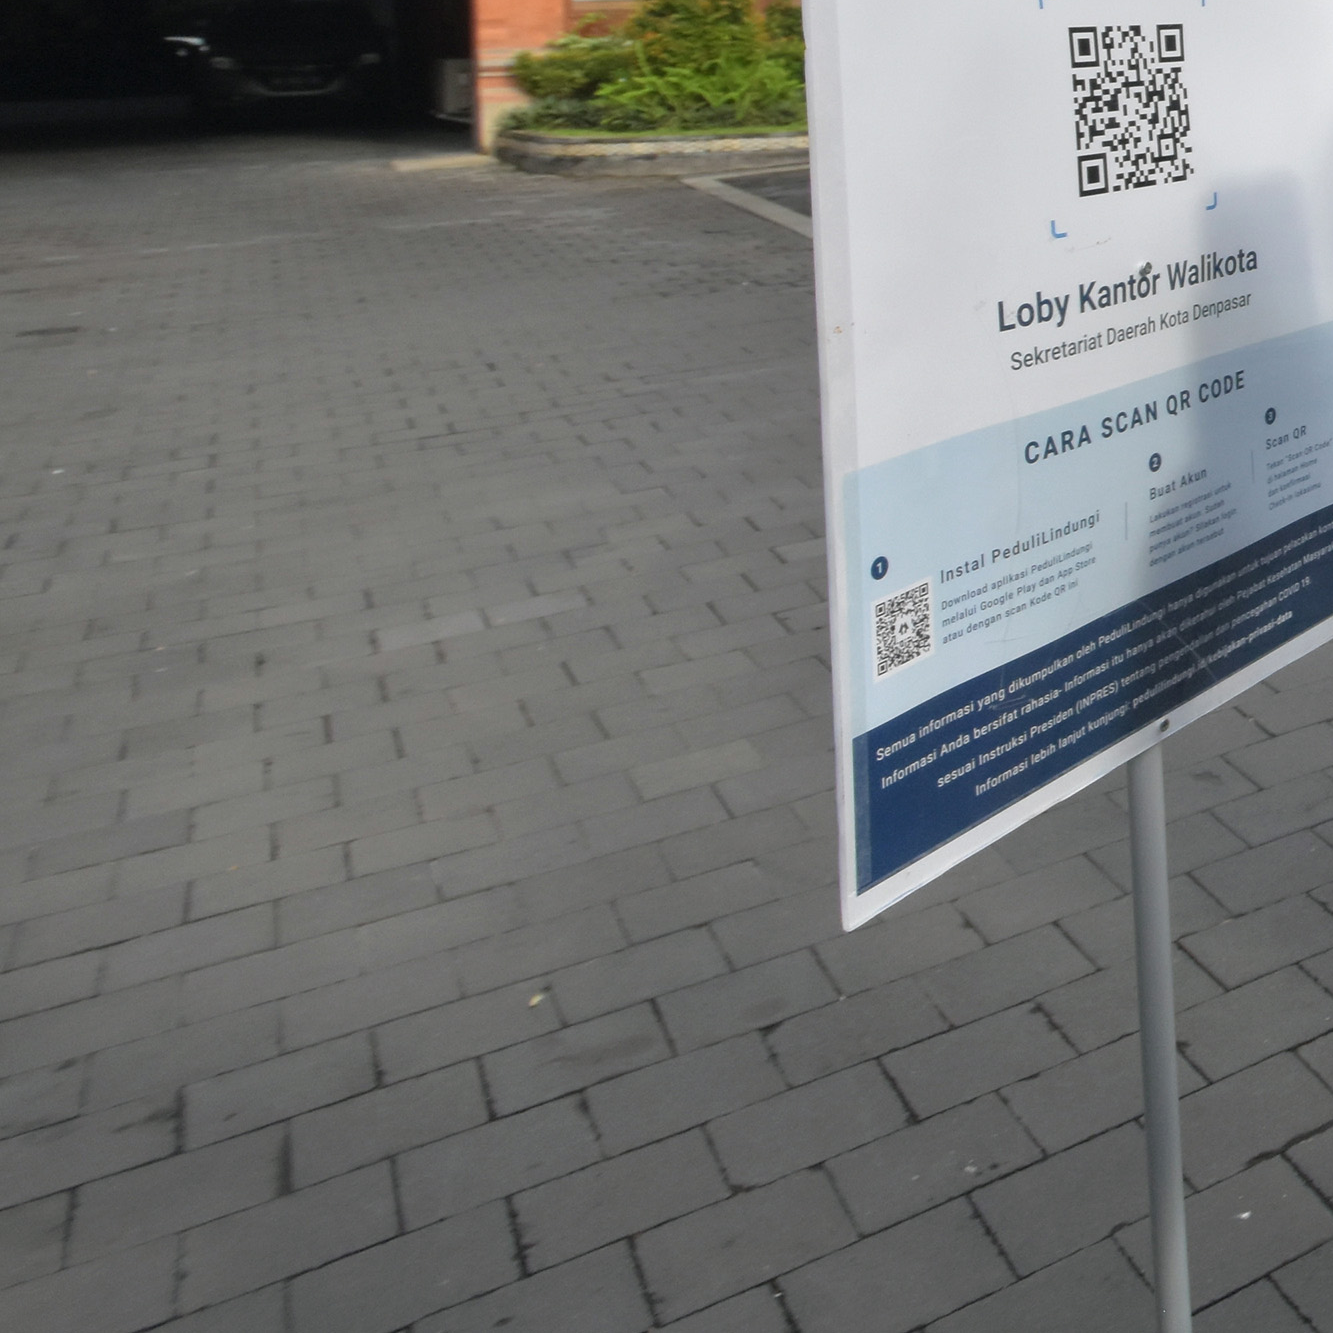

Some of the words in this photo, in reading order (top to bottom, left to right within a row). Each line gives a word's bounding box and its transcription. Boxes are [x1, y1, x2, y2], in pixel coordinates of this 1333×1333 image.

[997, 290, 1071, 333] Loby
[1078, 274, 1162, 314] Kantor
[1166, 248, 1258, 291] Walikota
[1010, 331, 1103, 371] Sekretariat
[1106, 315, 1156, 346] Daerah
[1159, 309, 1190, 331] Kota
[1192, 292, 1252, 321] Denpasar
[1024, 424, 1092, 465] CARA
[1101, 399, 1158, 439] SCAN
[1165, 388, 1191, 416] QR
[1198, 369, 1245, 404] CODE
[1265, 432, 1289, 450] Scan
[1292, 424, 1307, 440] QR
[1149, 479, 1177, 501] Buat
[1179, 468, 1208, 488] Akun
[940, 552, 985, 584] Instal
[991, 508, 1100, 564] PeduliLindungi
[940, 582, 989, 611] Download
[990, 568, 1029, 590] aplikasi
[1030, 542, 1094, 575] PeduliLindungi
[941, 605, 977, 628] melalui
[979, 590, 1015, 611] Google
[1016, 581, 1037, 596] Play
[1038, 574, 1055, 587] dan
[1057, 566, 1074, 580] App
[1074, 555, 1097, 572] Store
[942, 628, 964, 645] atau
[966, 612, 1003, 634] dengan
[1005, 602, 1028, 618] scan
[1029, 591, 1053, 607] Kode
[1054, 583, 1067, 597] QR
[1068, 579, 1079, 590] ini
[876, 732, 917, 761] Semua
[918, 699, 975, 739] informasi
[977, 687, 1006, 712] yang
[1008, 653, 1075, 694] dikumpulkan
[1075, 640, 1097, 660] oleh
[1098, 607, 1167, 648] PeduliLindungi
[881, 750, 938, 789] Informasi
[939, 733, 971, 757] Anda
[973, 708, 1018, 740] bersifat
[1064, 660, 1110, 692] Informasi
[1111, 653, 1125, 667] itu
[1125, 637, 1155, 659] hanya
[937, 757, 976, 788] sesuai
[978, 732, 1028, 766] Instruksi
[1029, 706, 1074, 739] Presiden
[1075, 679, 1120, 715] (INPRES)
[1120, 662, 1157, 688] tentang
[975, 759, 1029, 796] Informasi
[1030, 742, 1057, 765] lebih
[1058, 725, 1087, 749] lanjut
